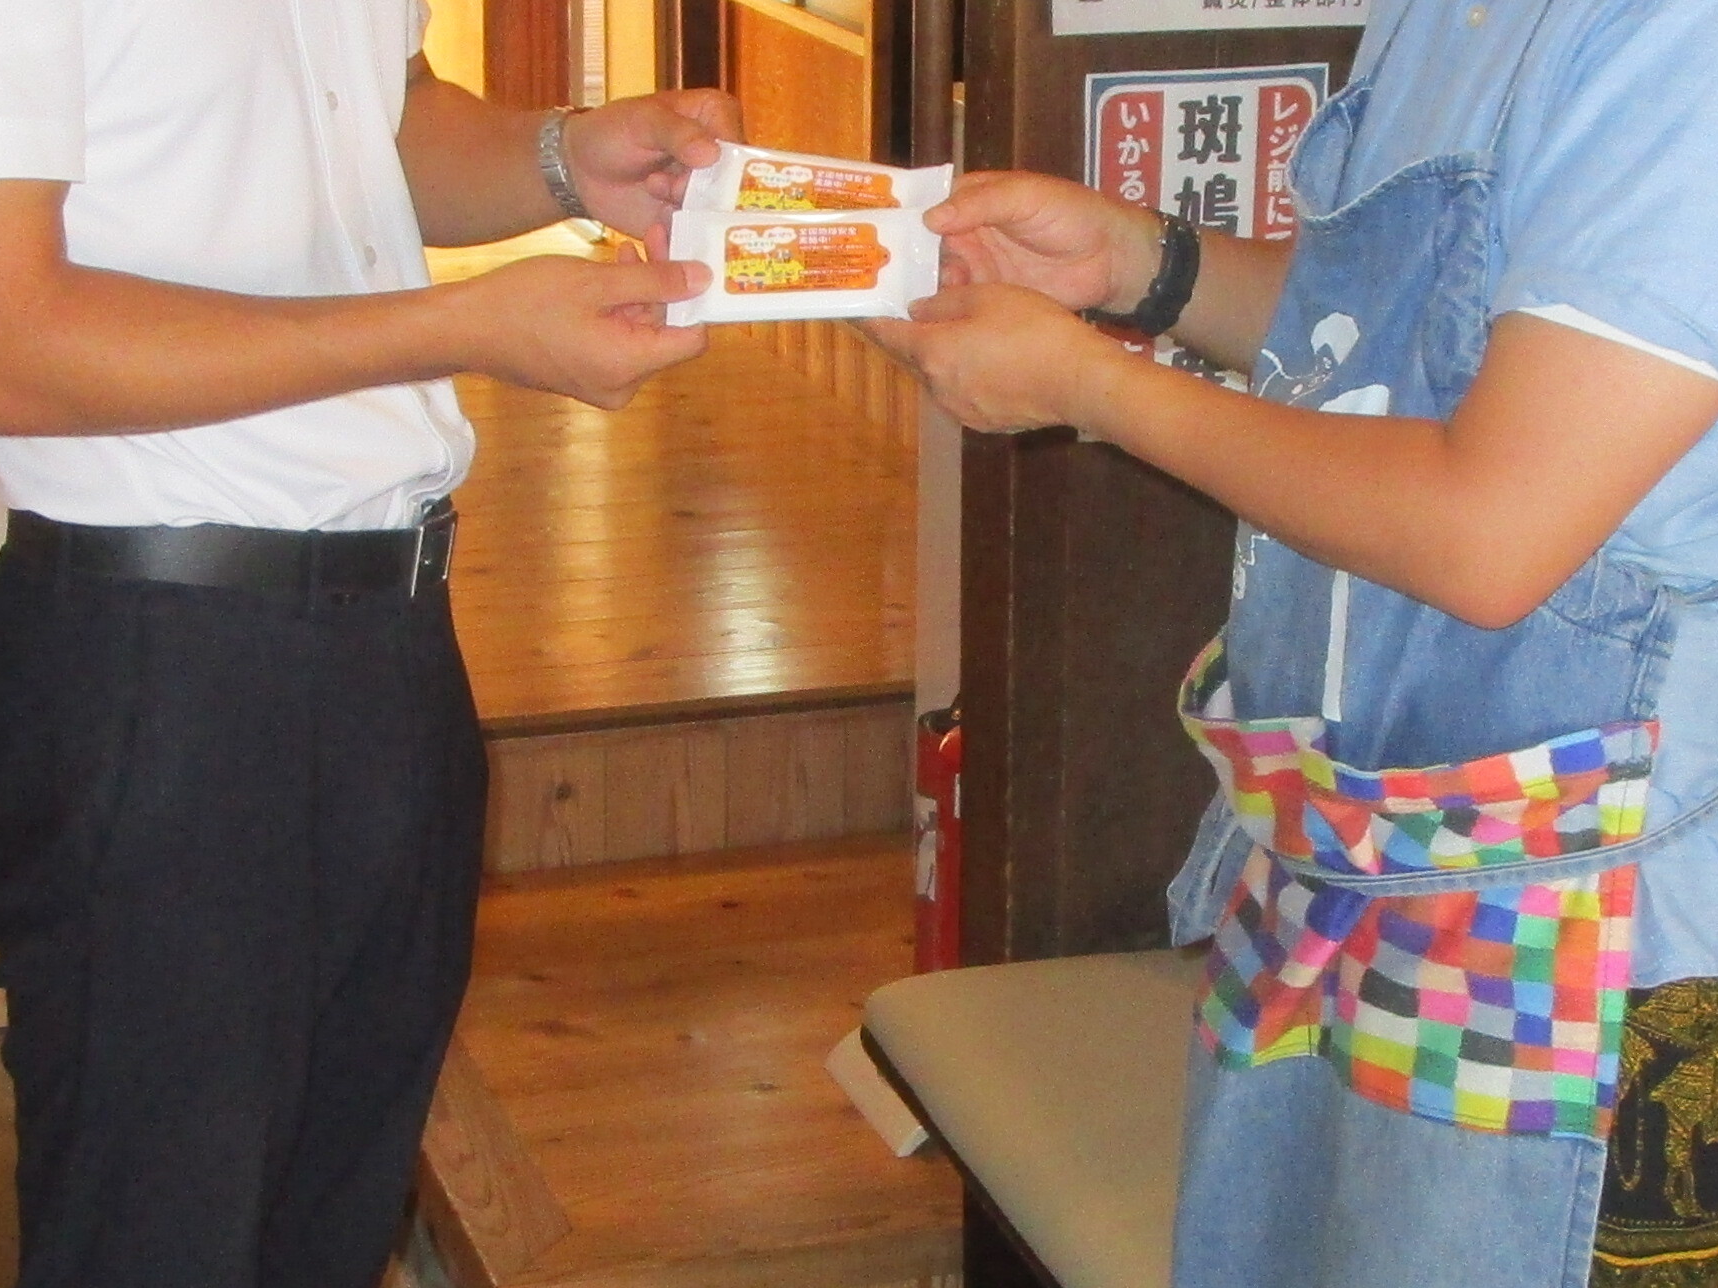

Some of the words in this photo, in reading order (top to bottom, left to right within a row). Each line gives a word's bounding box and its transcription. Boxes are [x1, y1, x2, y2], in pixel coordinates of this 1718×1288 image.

[1116, 101, 1152, 211] いかる
[1175, 94, 1243, 238] 斑鳩
